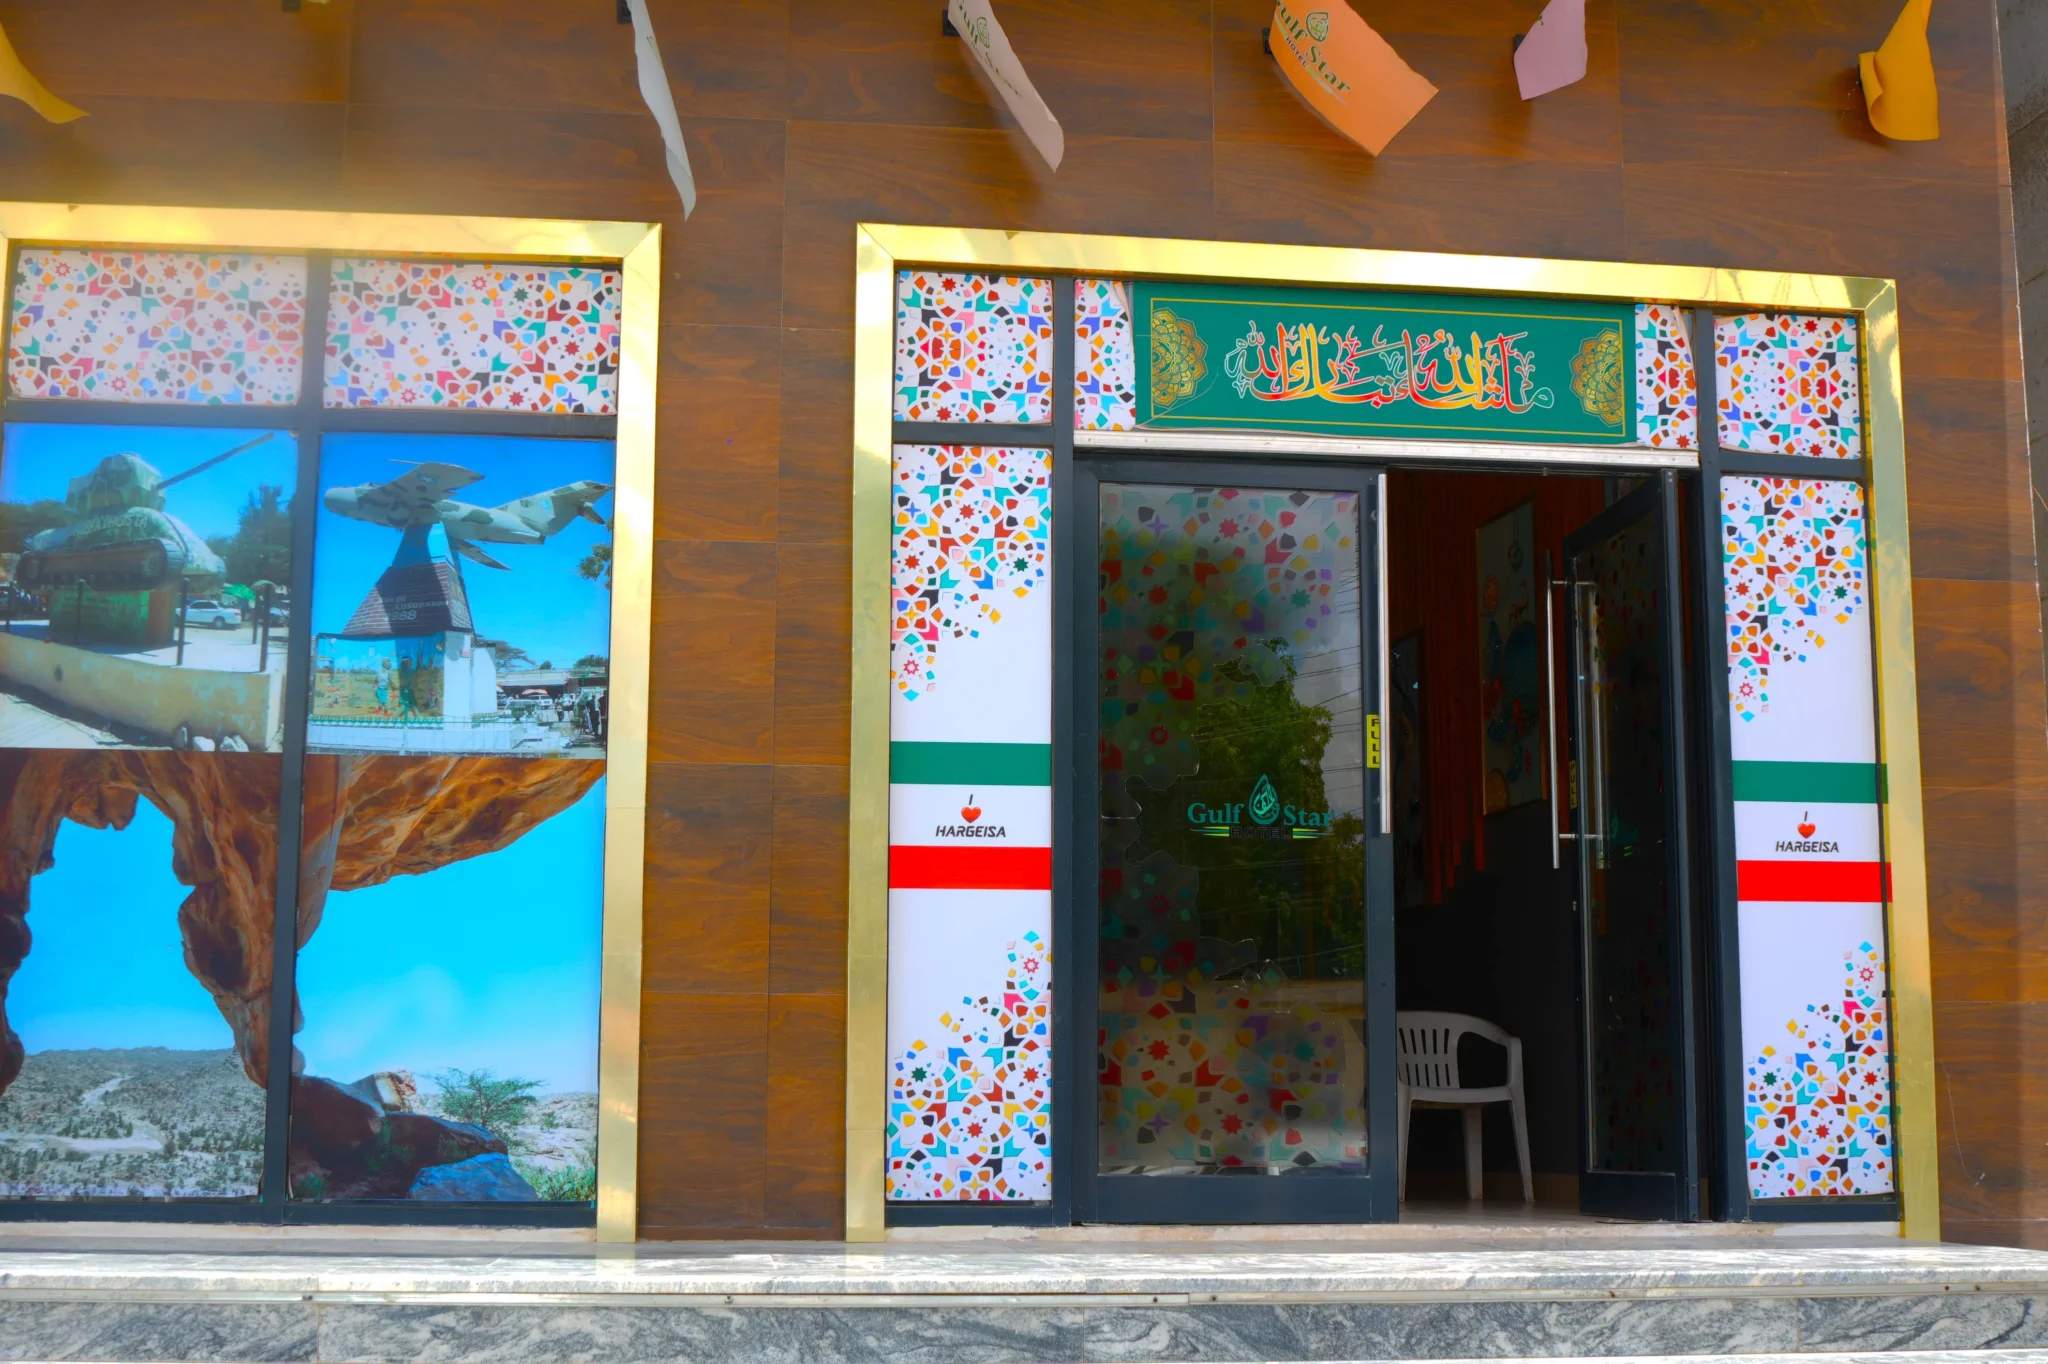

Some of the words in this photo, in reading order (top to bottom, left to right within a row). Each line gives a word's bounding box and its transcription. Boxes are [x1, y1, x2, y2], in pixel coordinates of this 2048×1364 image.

[1276, 0, 1308, 41] ulf
[1305, 45, 1352, 92] Star
[1285, 36, 1308, 69] HOTEL
[968, 794, 974, 806] I
[1187, 803, 1245, 825] Gulf
[1283, 805, 1336, 827] Star
[1803, 811, 1808, 822] I
[935, 825, 1006, 838] HARGEISA
[1230, 826, 1293, 840] HOTEL
[1775, 841, 1839, 853] HARGEISA
